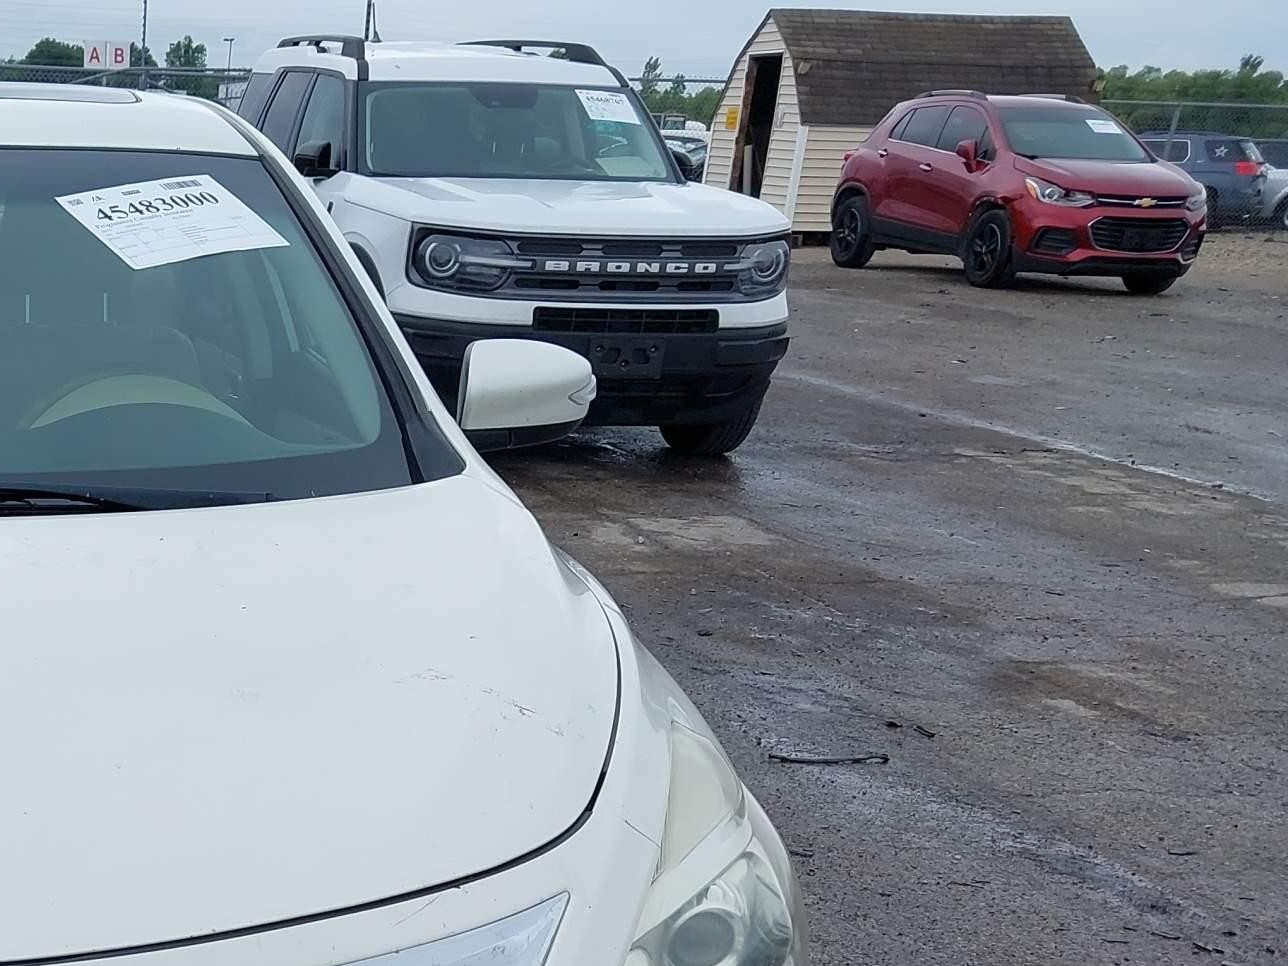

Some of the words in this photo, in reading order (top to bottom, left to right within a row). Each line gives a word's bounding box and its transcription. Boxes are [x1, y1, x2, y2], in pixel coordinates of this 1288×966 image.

[88, 46, 101, 63] A
[114, 47, 125, 64] B
[96, 190, 219, 222] 45483000
[544, 260, 717, 274] BRONCO
